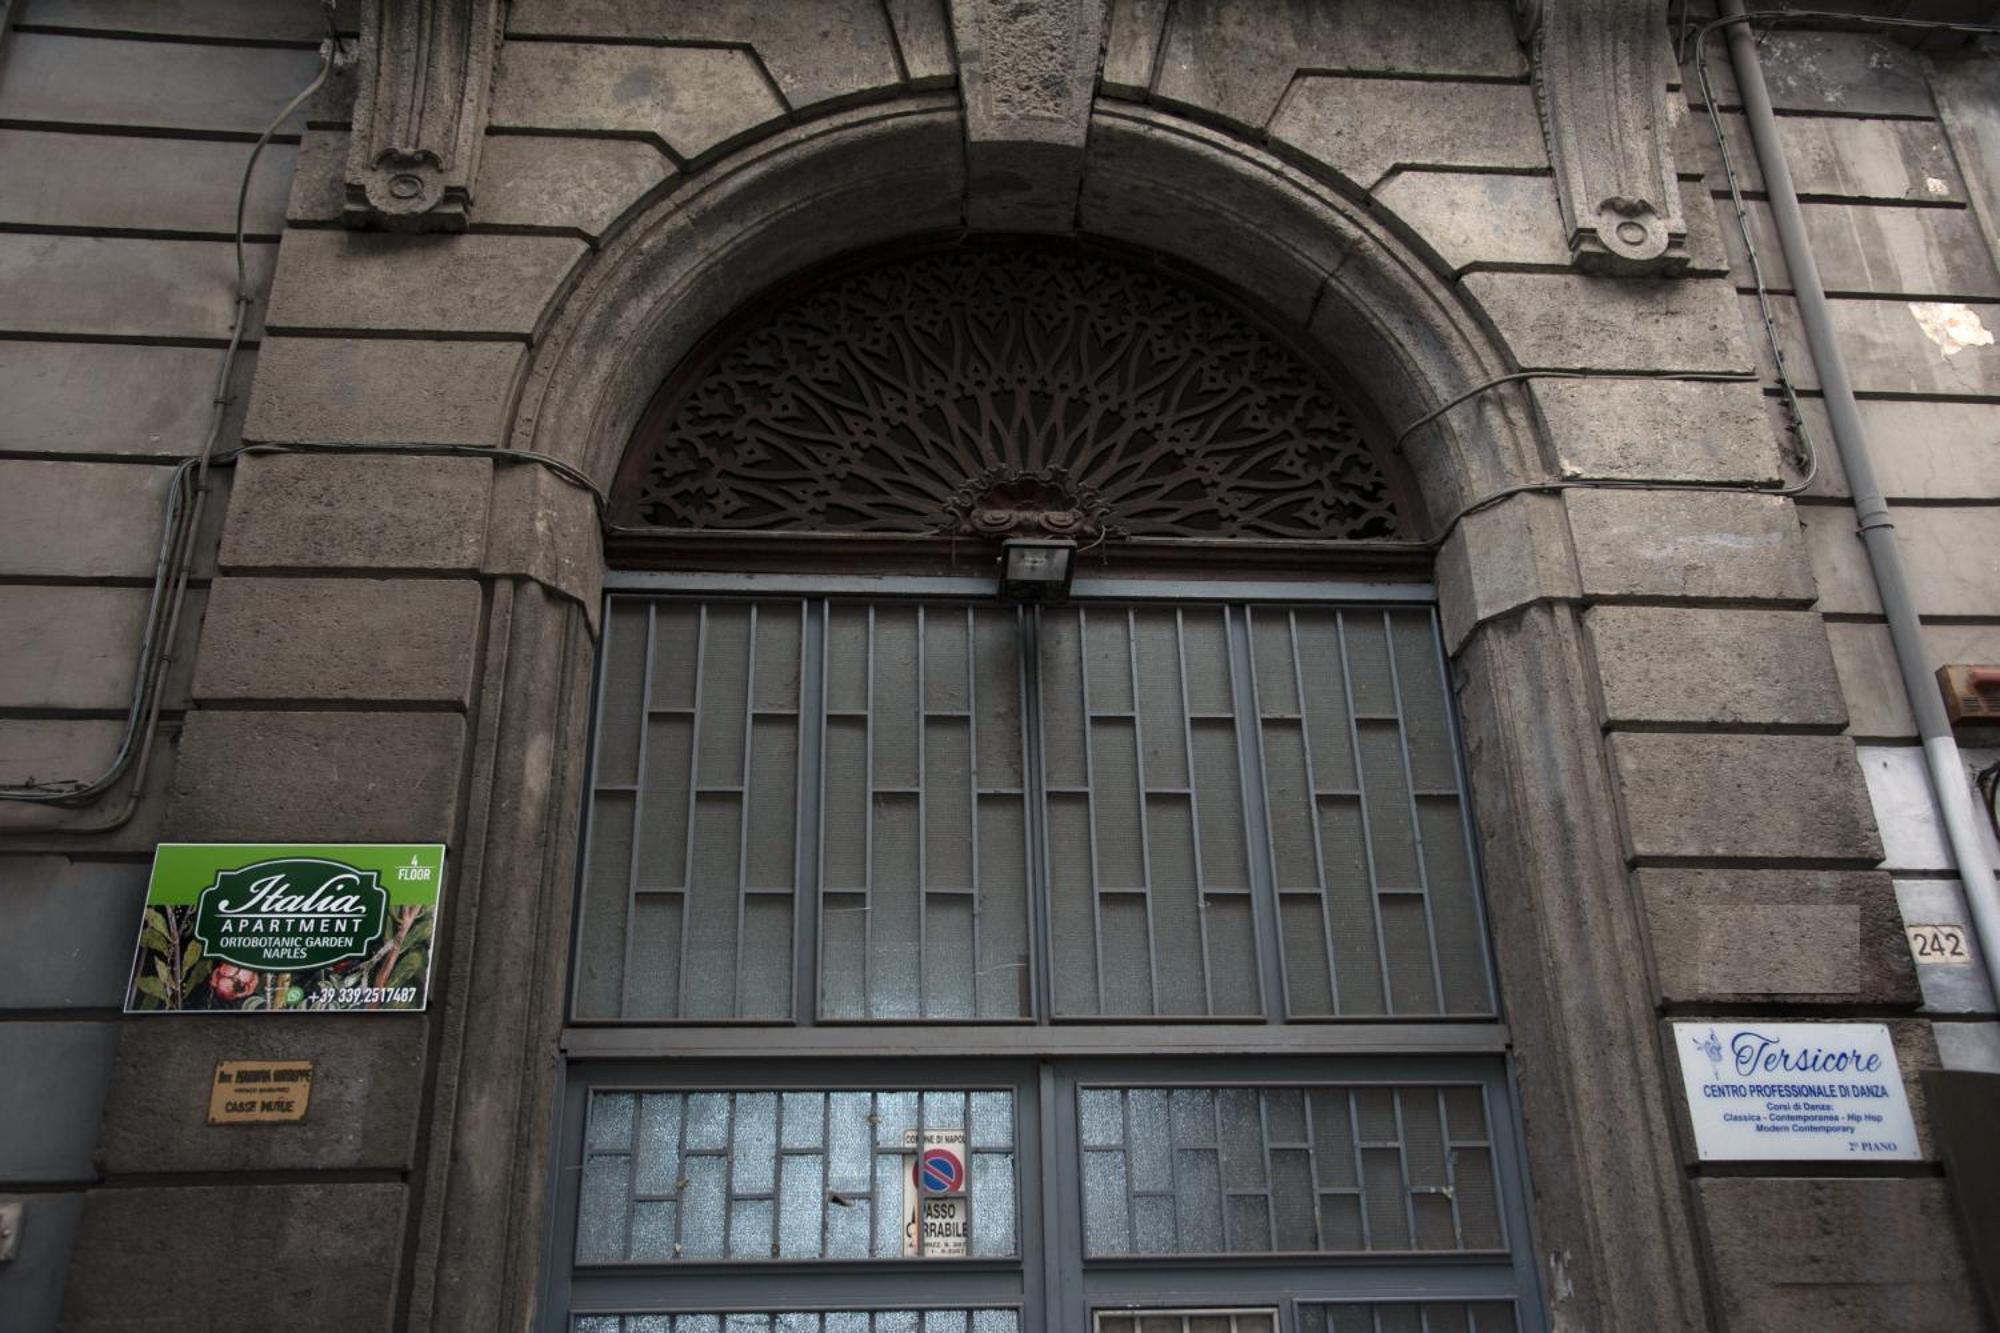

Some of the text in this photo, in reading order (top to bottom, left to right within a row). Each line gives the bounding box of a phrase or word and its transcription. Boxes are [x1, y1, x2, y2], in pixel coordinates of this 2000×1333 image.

[411, 854, 418, 867] 4
[398, 868, 431, 880] FLOOR
[218, 873, 367, 913] Italia
[221, 919, 363, 933] APARTMENT
[220, 936, 353, 948] ORTOBOTANIC GARDEN
[1914, 933, 1963, 956] 242
[263, 948, 307, 959] NAPLES
[308, 987, 416, 1003] +39 339.2517487
[1732, 1032, 1881, 1076] Tersicore
[1704, 1085, 1888, 1098] CENTRO PROFESSIONALE DI DANZA
[1766, 1102, 1791, 1111] Corsi
[1793, 1102, 1801, 1111] di
[1723, 1113, 1761, 1122] Classica
[1769, 1113, 1839, 1123] Contemporanea
[1847, 1113, 1862, 1124] Hip
[1865, 1113, 1883, 1124] Hop
[1756, 1124, 1855, 1134] Modern Contemporary
[1861, 1142, 1897, 1151] PIANO
[923, 1203, 956, 1219] ASSO
[906, 1222, 969, 1238] CRRABILE
